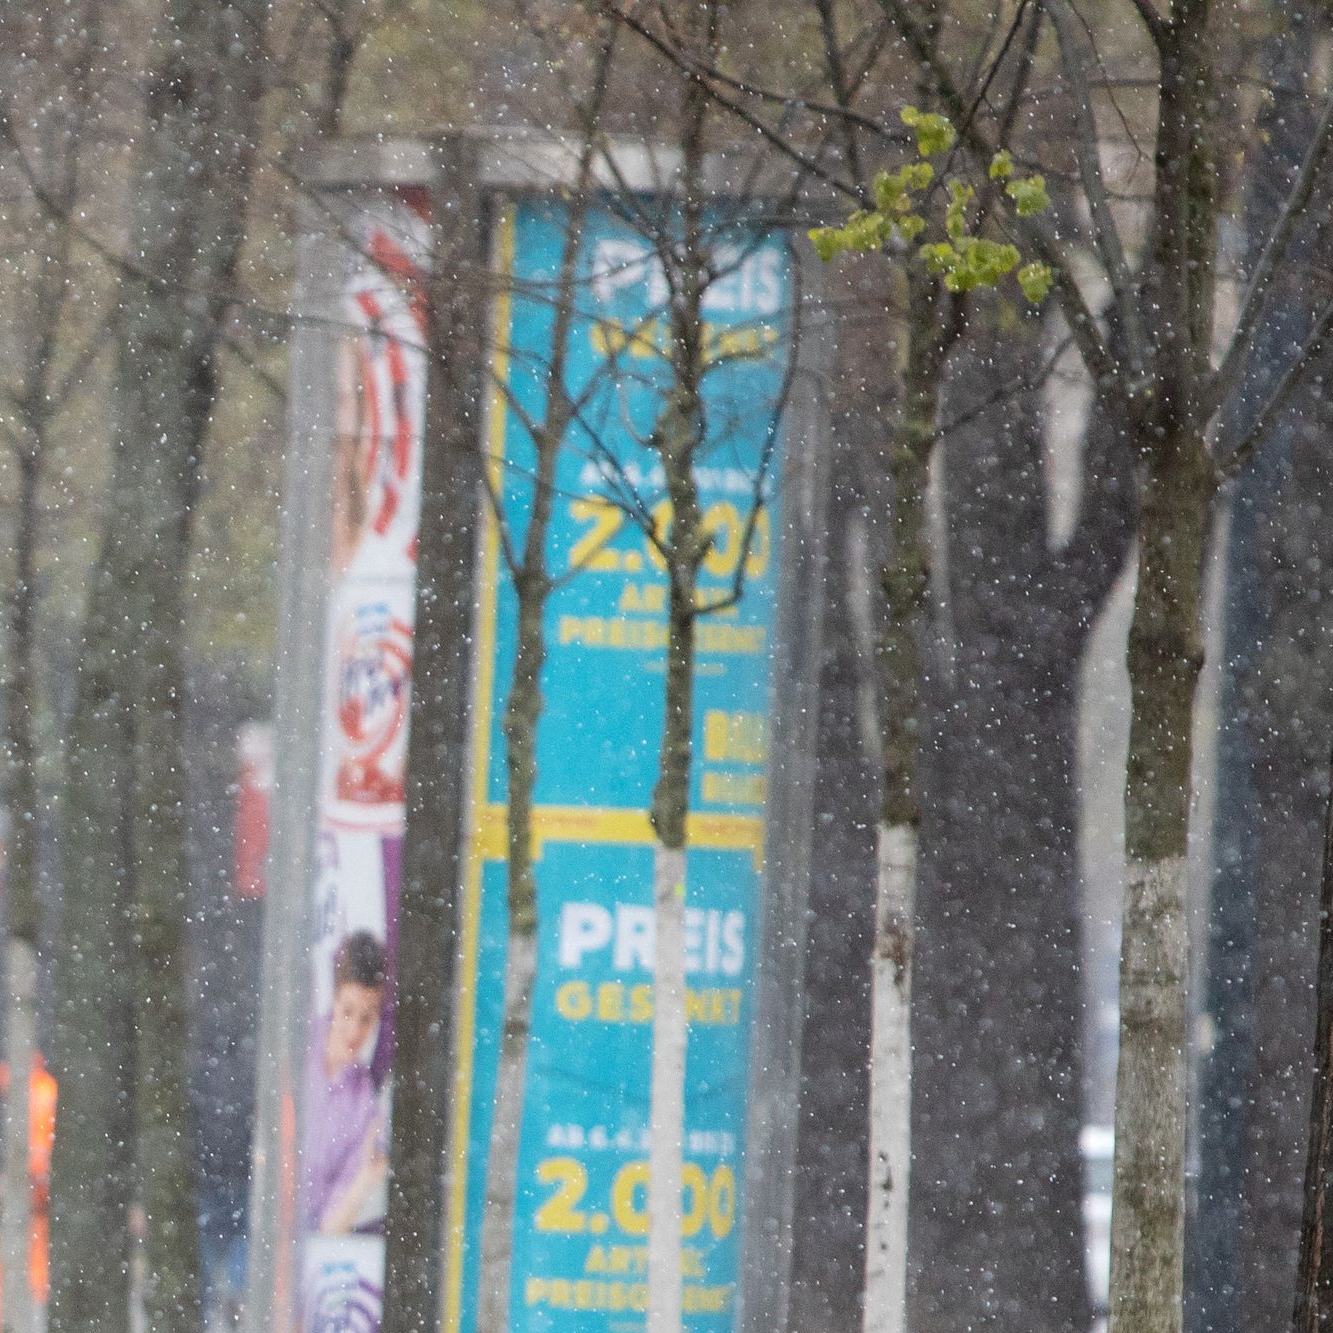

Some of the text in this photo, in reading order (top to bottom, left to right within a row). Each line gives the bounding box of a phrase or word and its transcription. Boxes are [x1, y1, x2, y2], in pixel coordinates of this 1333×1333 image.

[558, 902, 747, 976] PREIS
[554, 981, 742, 1026] GESNKT
[534, 1156, 735, 1238] 2.000
